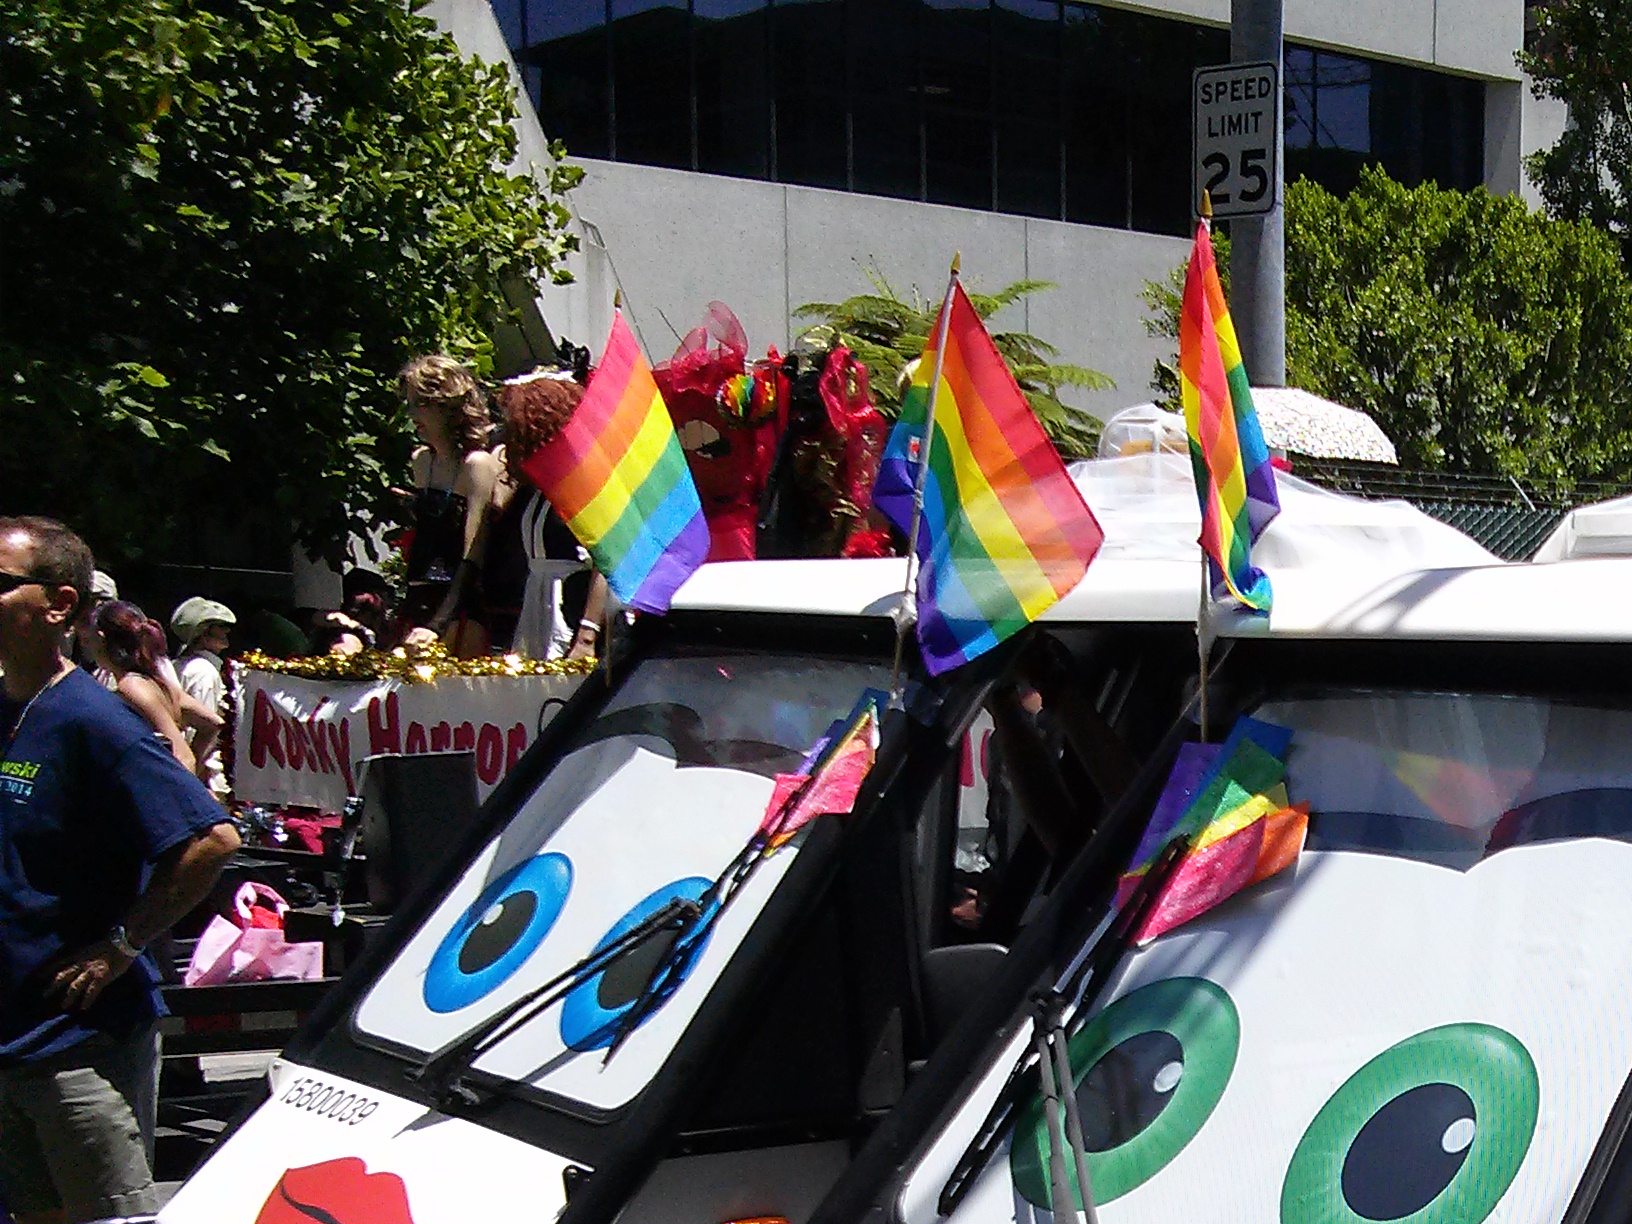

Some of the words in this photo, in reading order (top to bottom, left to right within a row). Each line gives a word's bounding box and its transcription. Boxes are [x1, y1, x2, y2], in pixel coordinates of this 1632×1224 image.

[1201, 77, 1271, 104] SPEED
[1208, 111, 1262, 137] LIMIT
[1202, 149, 1267, 203] 25
[250, 689, 356, 794] Rocky
[280, 1077, 379, 1126] 15800039
